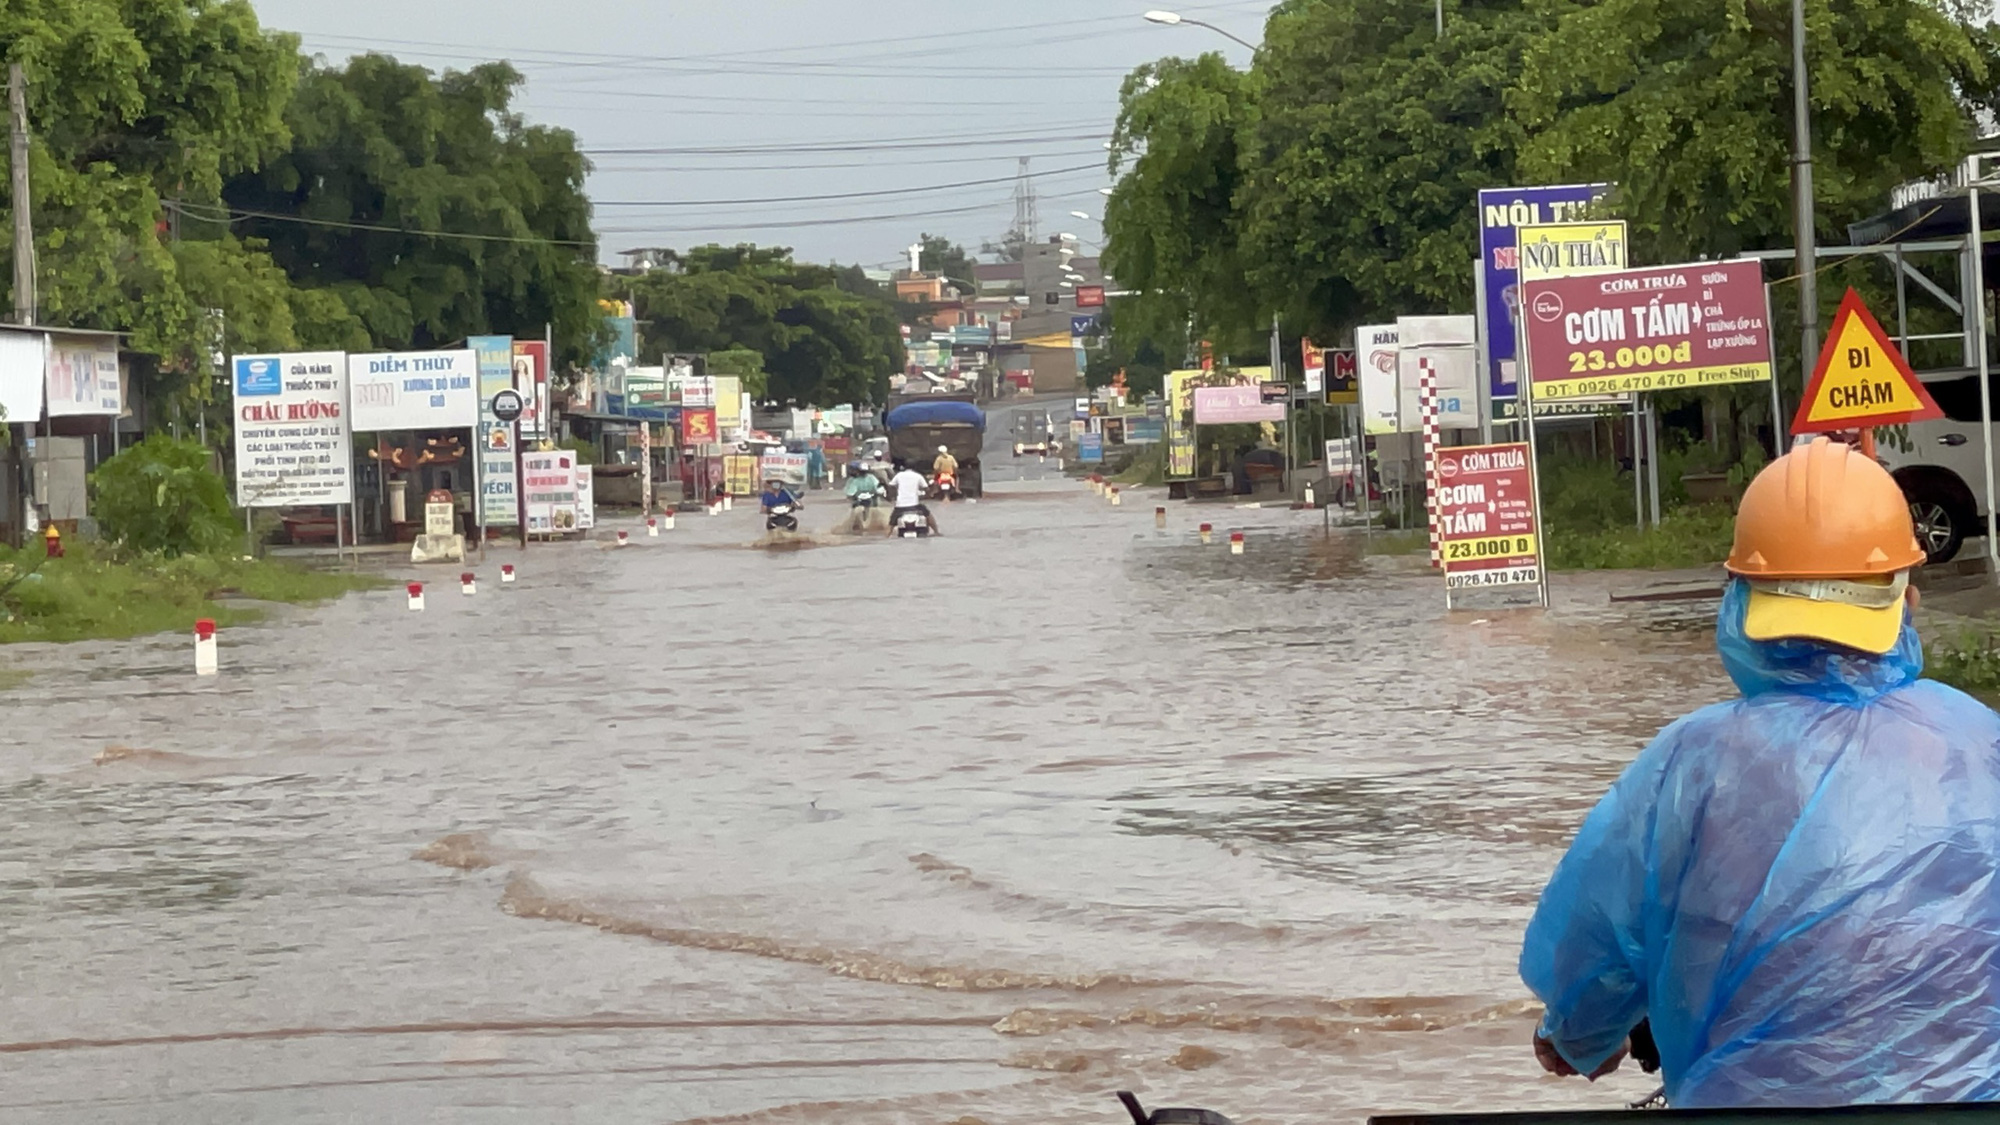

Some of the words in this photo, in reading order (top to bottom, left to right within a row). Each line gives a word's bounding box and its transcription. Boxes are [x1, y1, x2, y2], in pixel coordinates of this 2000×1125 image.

[1523, 234, 1561, 273] NỘI
[1563, 227, 1621, 268] THẤT
[1600, 277, 1639, 293] CƠM
[1642, 273, 1687, 290] TRƯA
[1565, 306, 1626, 345] CƠM
[1631, 293, 1690, 339] TẤM
[1751, 318, 1763, 329] LA
[1568, 340, 1692, 373] 23.000đ
[1848, 346, 1871, 369] ĐI
[1657, 373, 1686, 387] 470
[1697, 370, 1727, 382] Free
[1729, 366, 1760, 380] Ship
[1829, 378, 1894, 409] CHẬM
[241, 400, 282, 421] CHÂU
[1491, 448, 1525, 468] TRƯA
[1439, 483, 1486, 506] CƠM
[1442, 507, 1487, 535] TẤM
[1449, 539, 1511, 558] 23.000
[1512, 569, 1536, 582] 470
